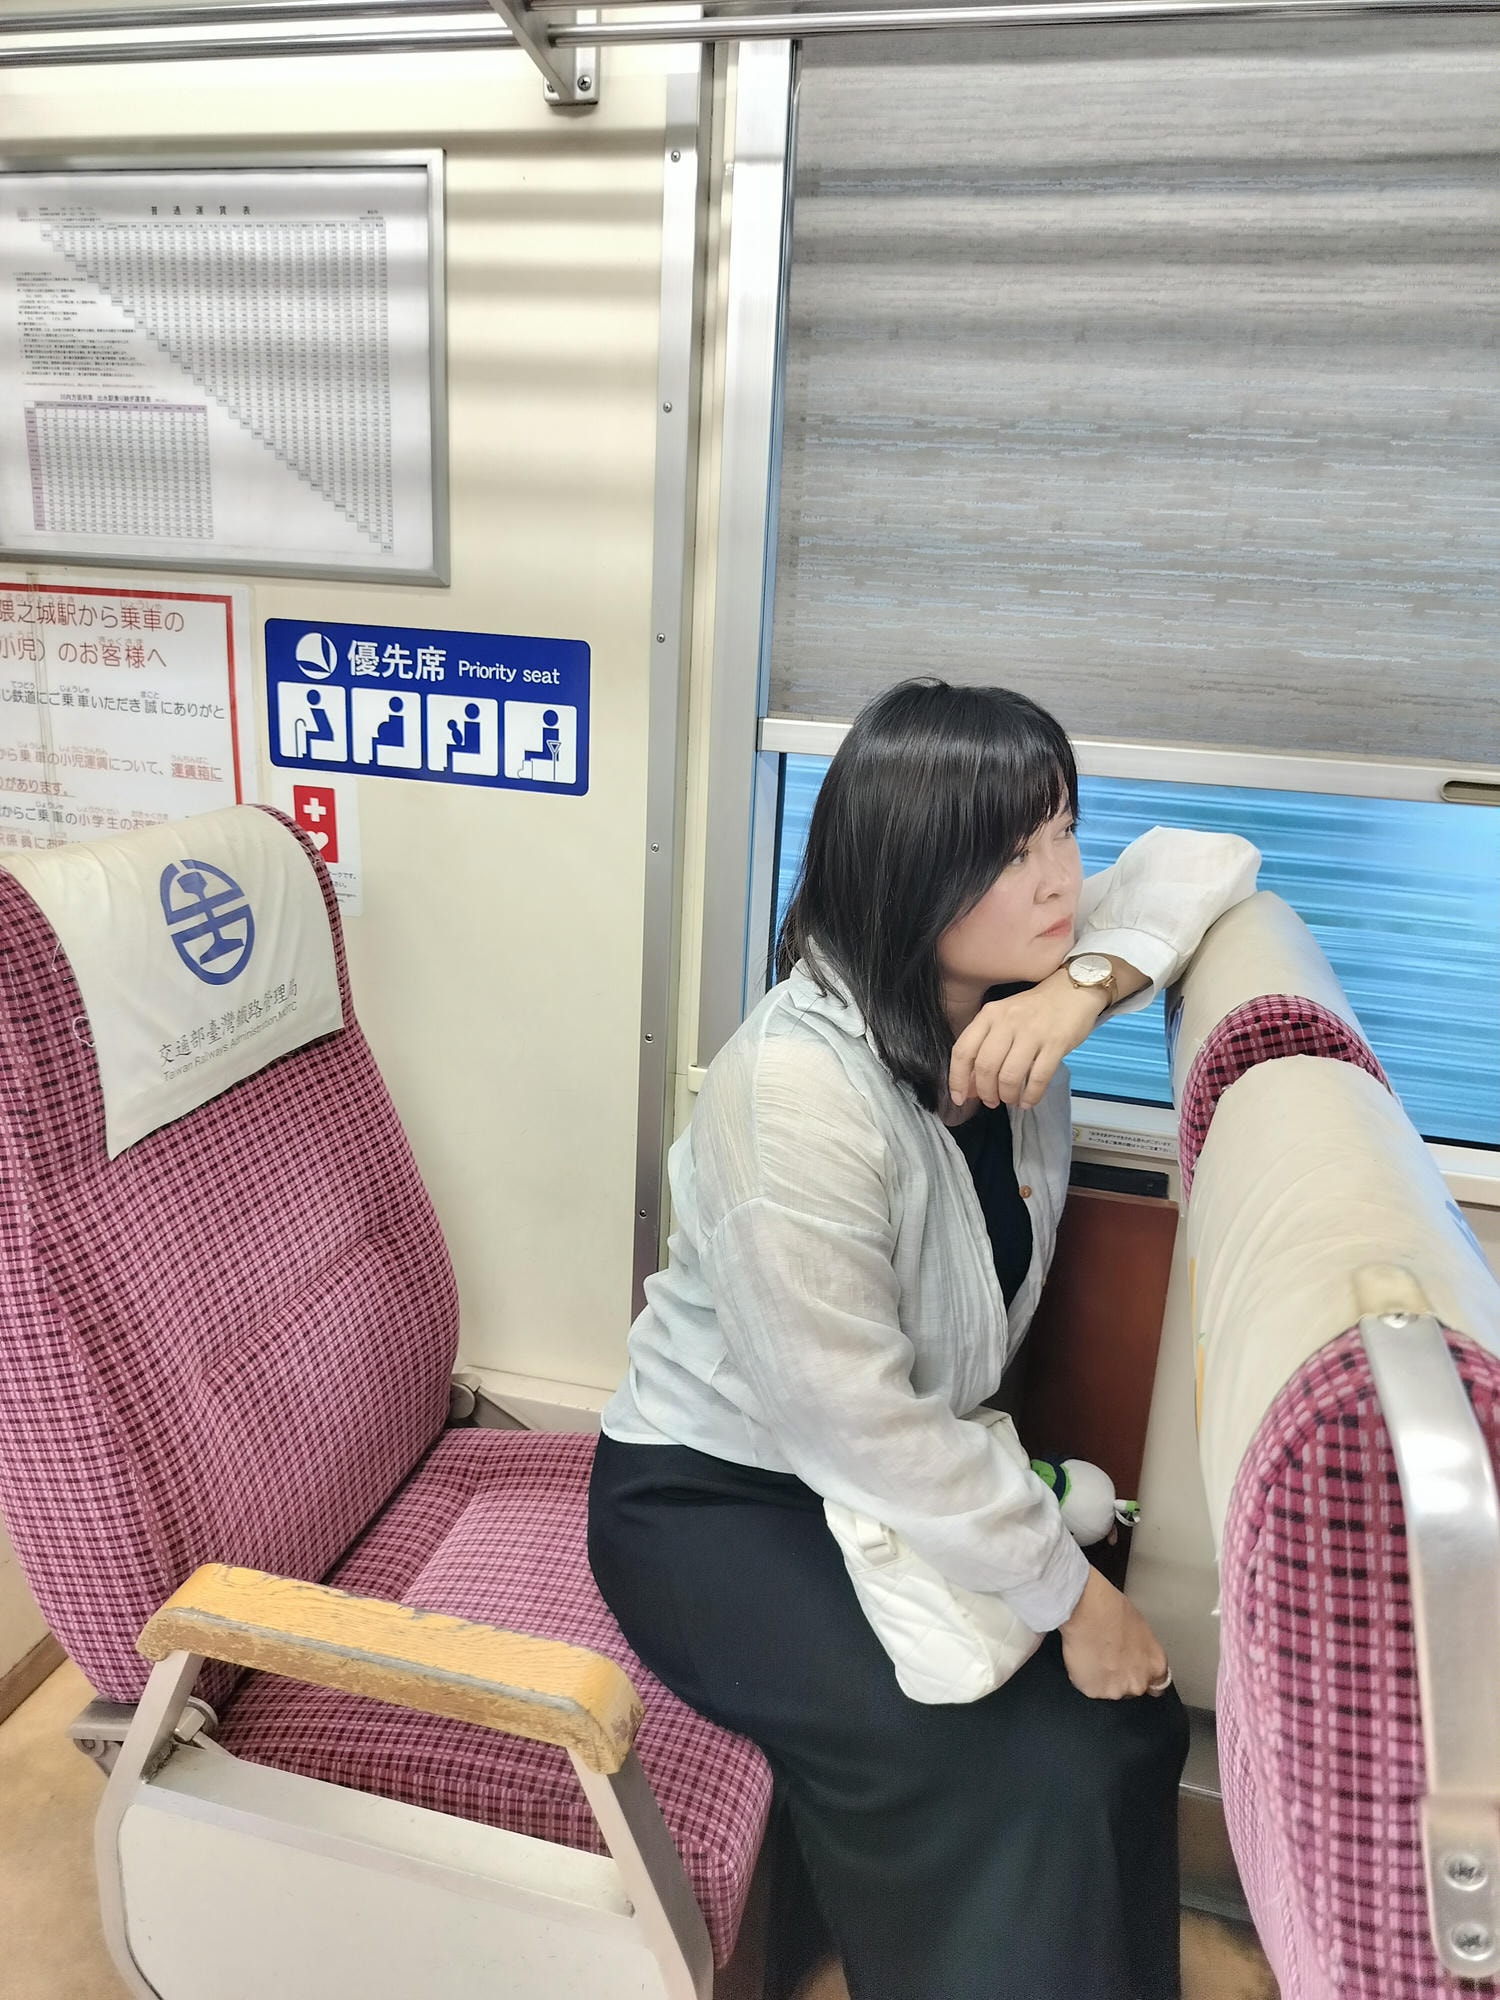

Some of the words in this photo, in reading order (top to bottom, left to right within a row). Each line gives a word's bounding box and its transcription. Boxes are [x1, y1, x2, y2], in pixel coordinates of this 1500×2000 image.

[347, 639, 448, 682] 優先席
[458, 660, 517, 683] Priority
[522, 668, 561, 685] seat
